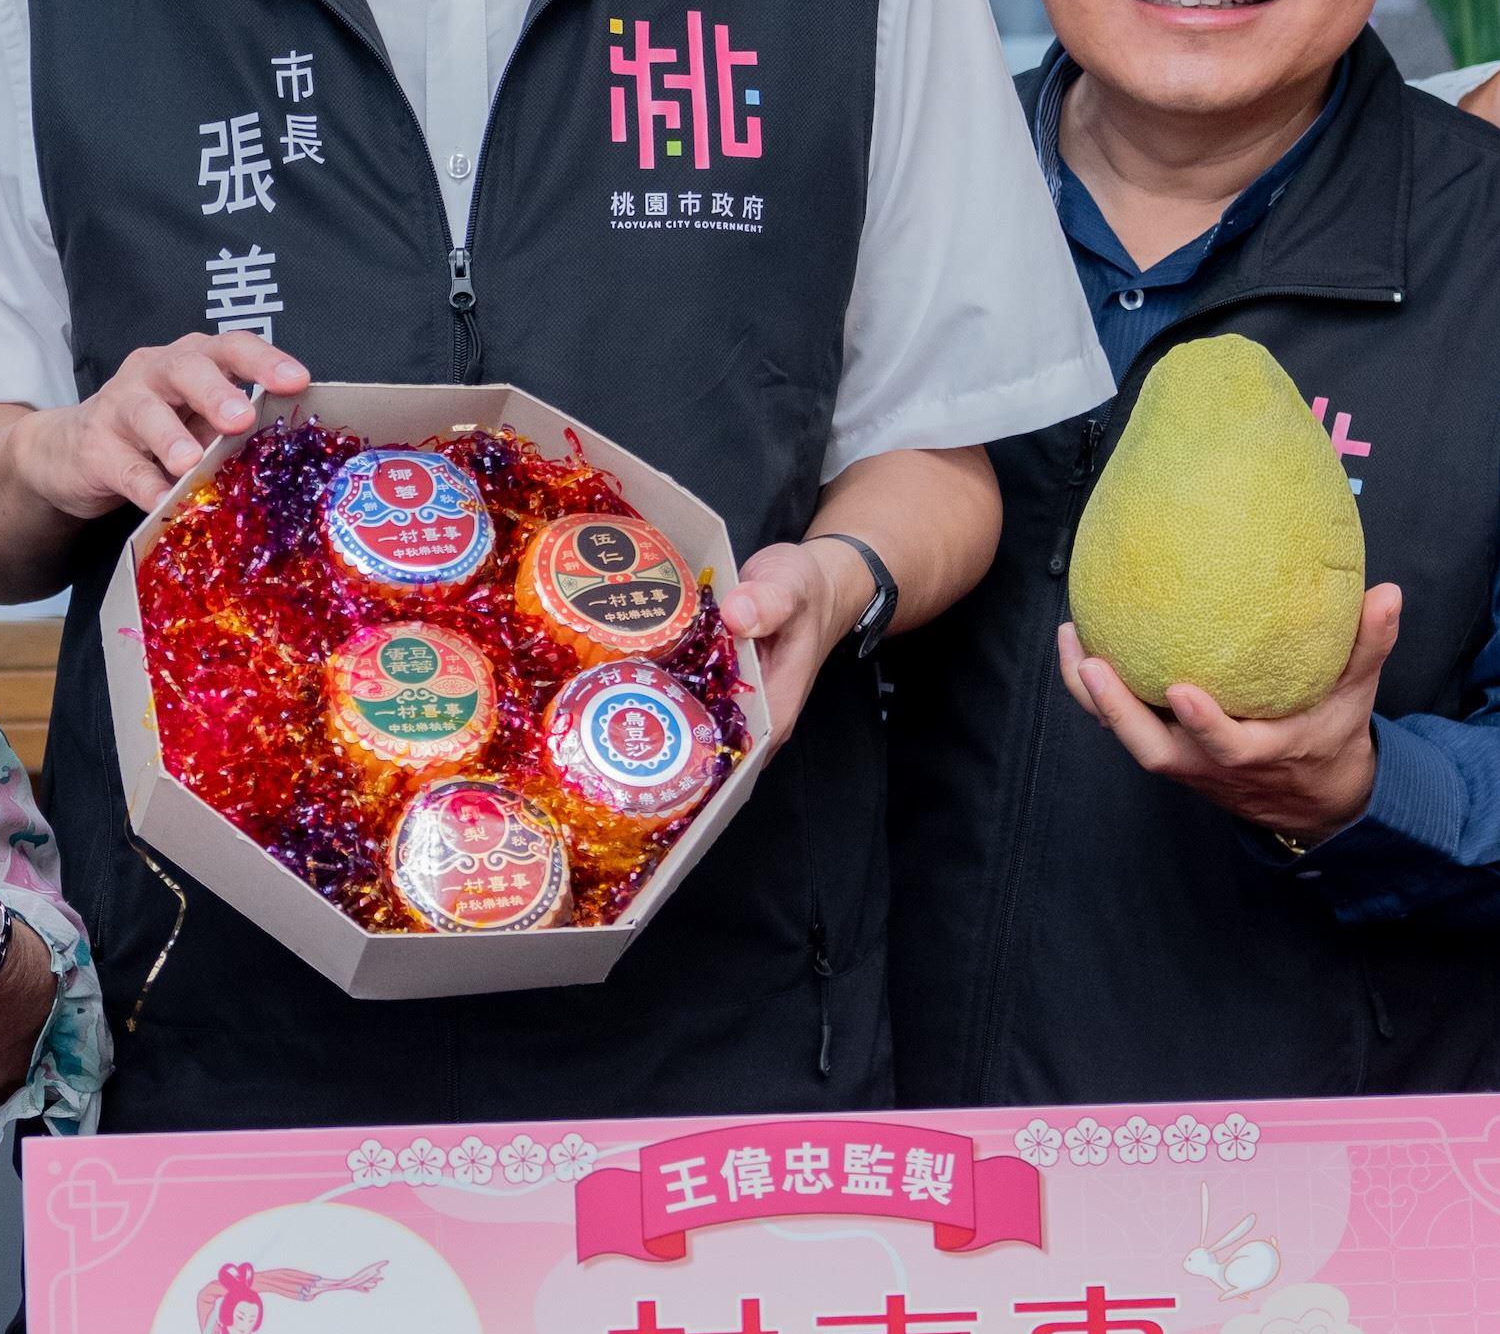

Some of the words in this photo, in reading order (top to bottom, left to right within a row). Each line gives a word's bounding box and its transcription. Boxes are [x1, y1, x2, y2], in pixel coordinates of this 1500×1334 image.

[271, 49, 325, 166] 市長
[610, 190, 764, 221] 桃園市政府
[610, 220, 662, 230] TAOYUAN
[666, 220, 691, 230] CITY
[694, 220, 764, 234] GOVERNMENT
[377, 526, 462, 544] 一村喜事
[589, 533, 624, 565] 伍仁
[588, 588, 669, 607] 一村喜事
[575, 668, 685, 703] 一村喜事
[375, 704, 463, 719] 一村喜事
[441, 873, 531, 895] 一村喜事
[659, 1140, 956, 1214] 王偉忠監製
